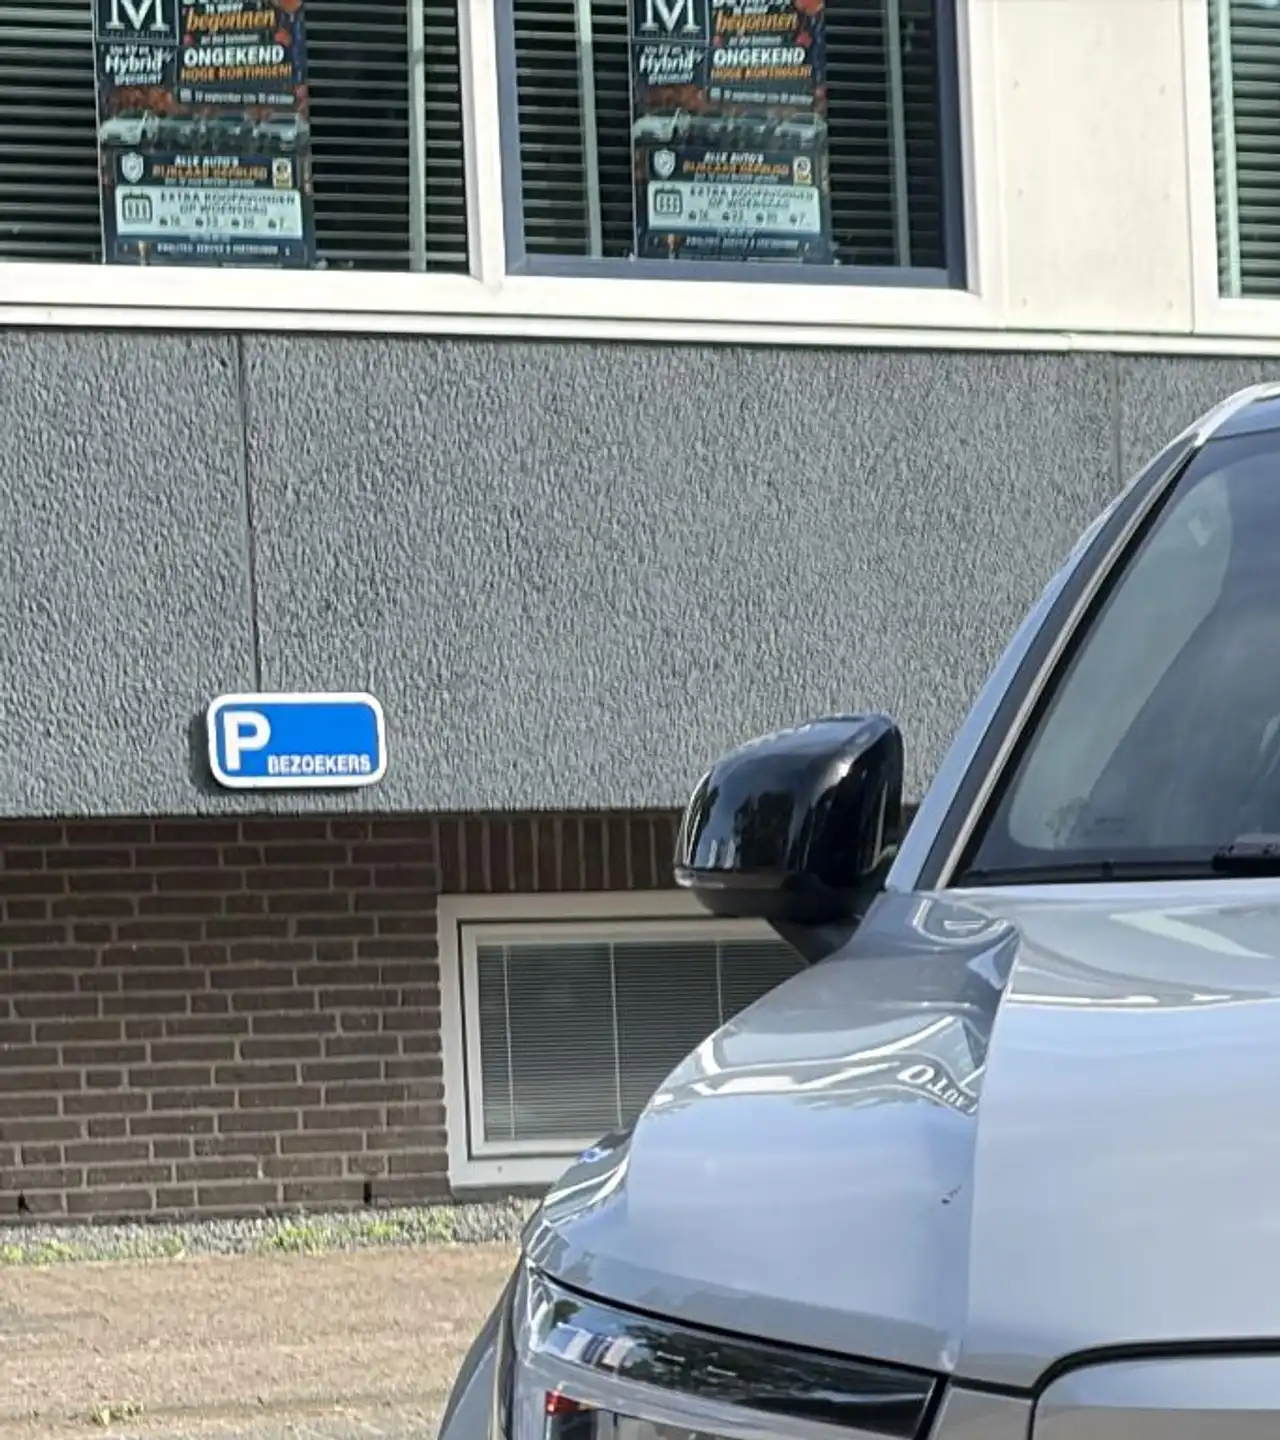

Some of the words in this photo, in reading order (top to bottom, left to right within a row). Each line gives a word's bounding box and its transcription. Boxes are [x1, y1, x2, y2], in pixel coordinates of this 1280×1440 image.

[186, 9, 276, 34] begonnen
[105, 52, 163, 75] Hybrid
[183, 45, 285, 67] ONGEKEND
[639, 53, 694, 75] Hybrid
[713, 47, 806, 67] ONGEKEND
[223, 711, 271, 771] P
[267, 754, 372, 775] BEZOEKERS
